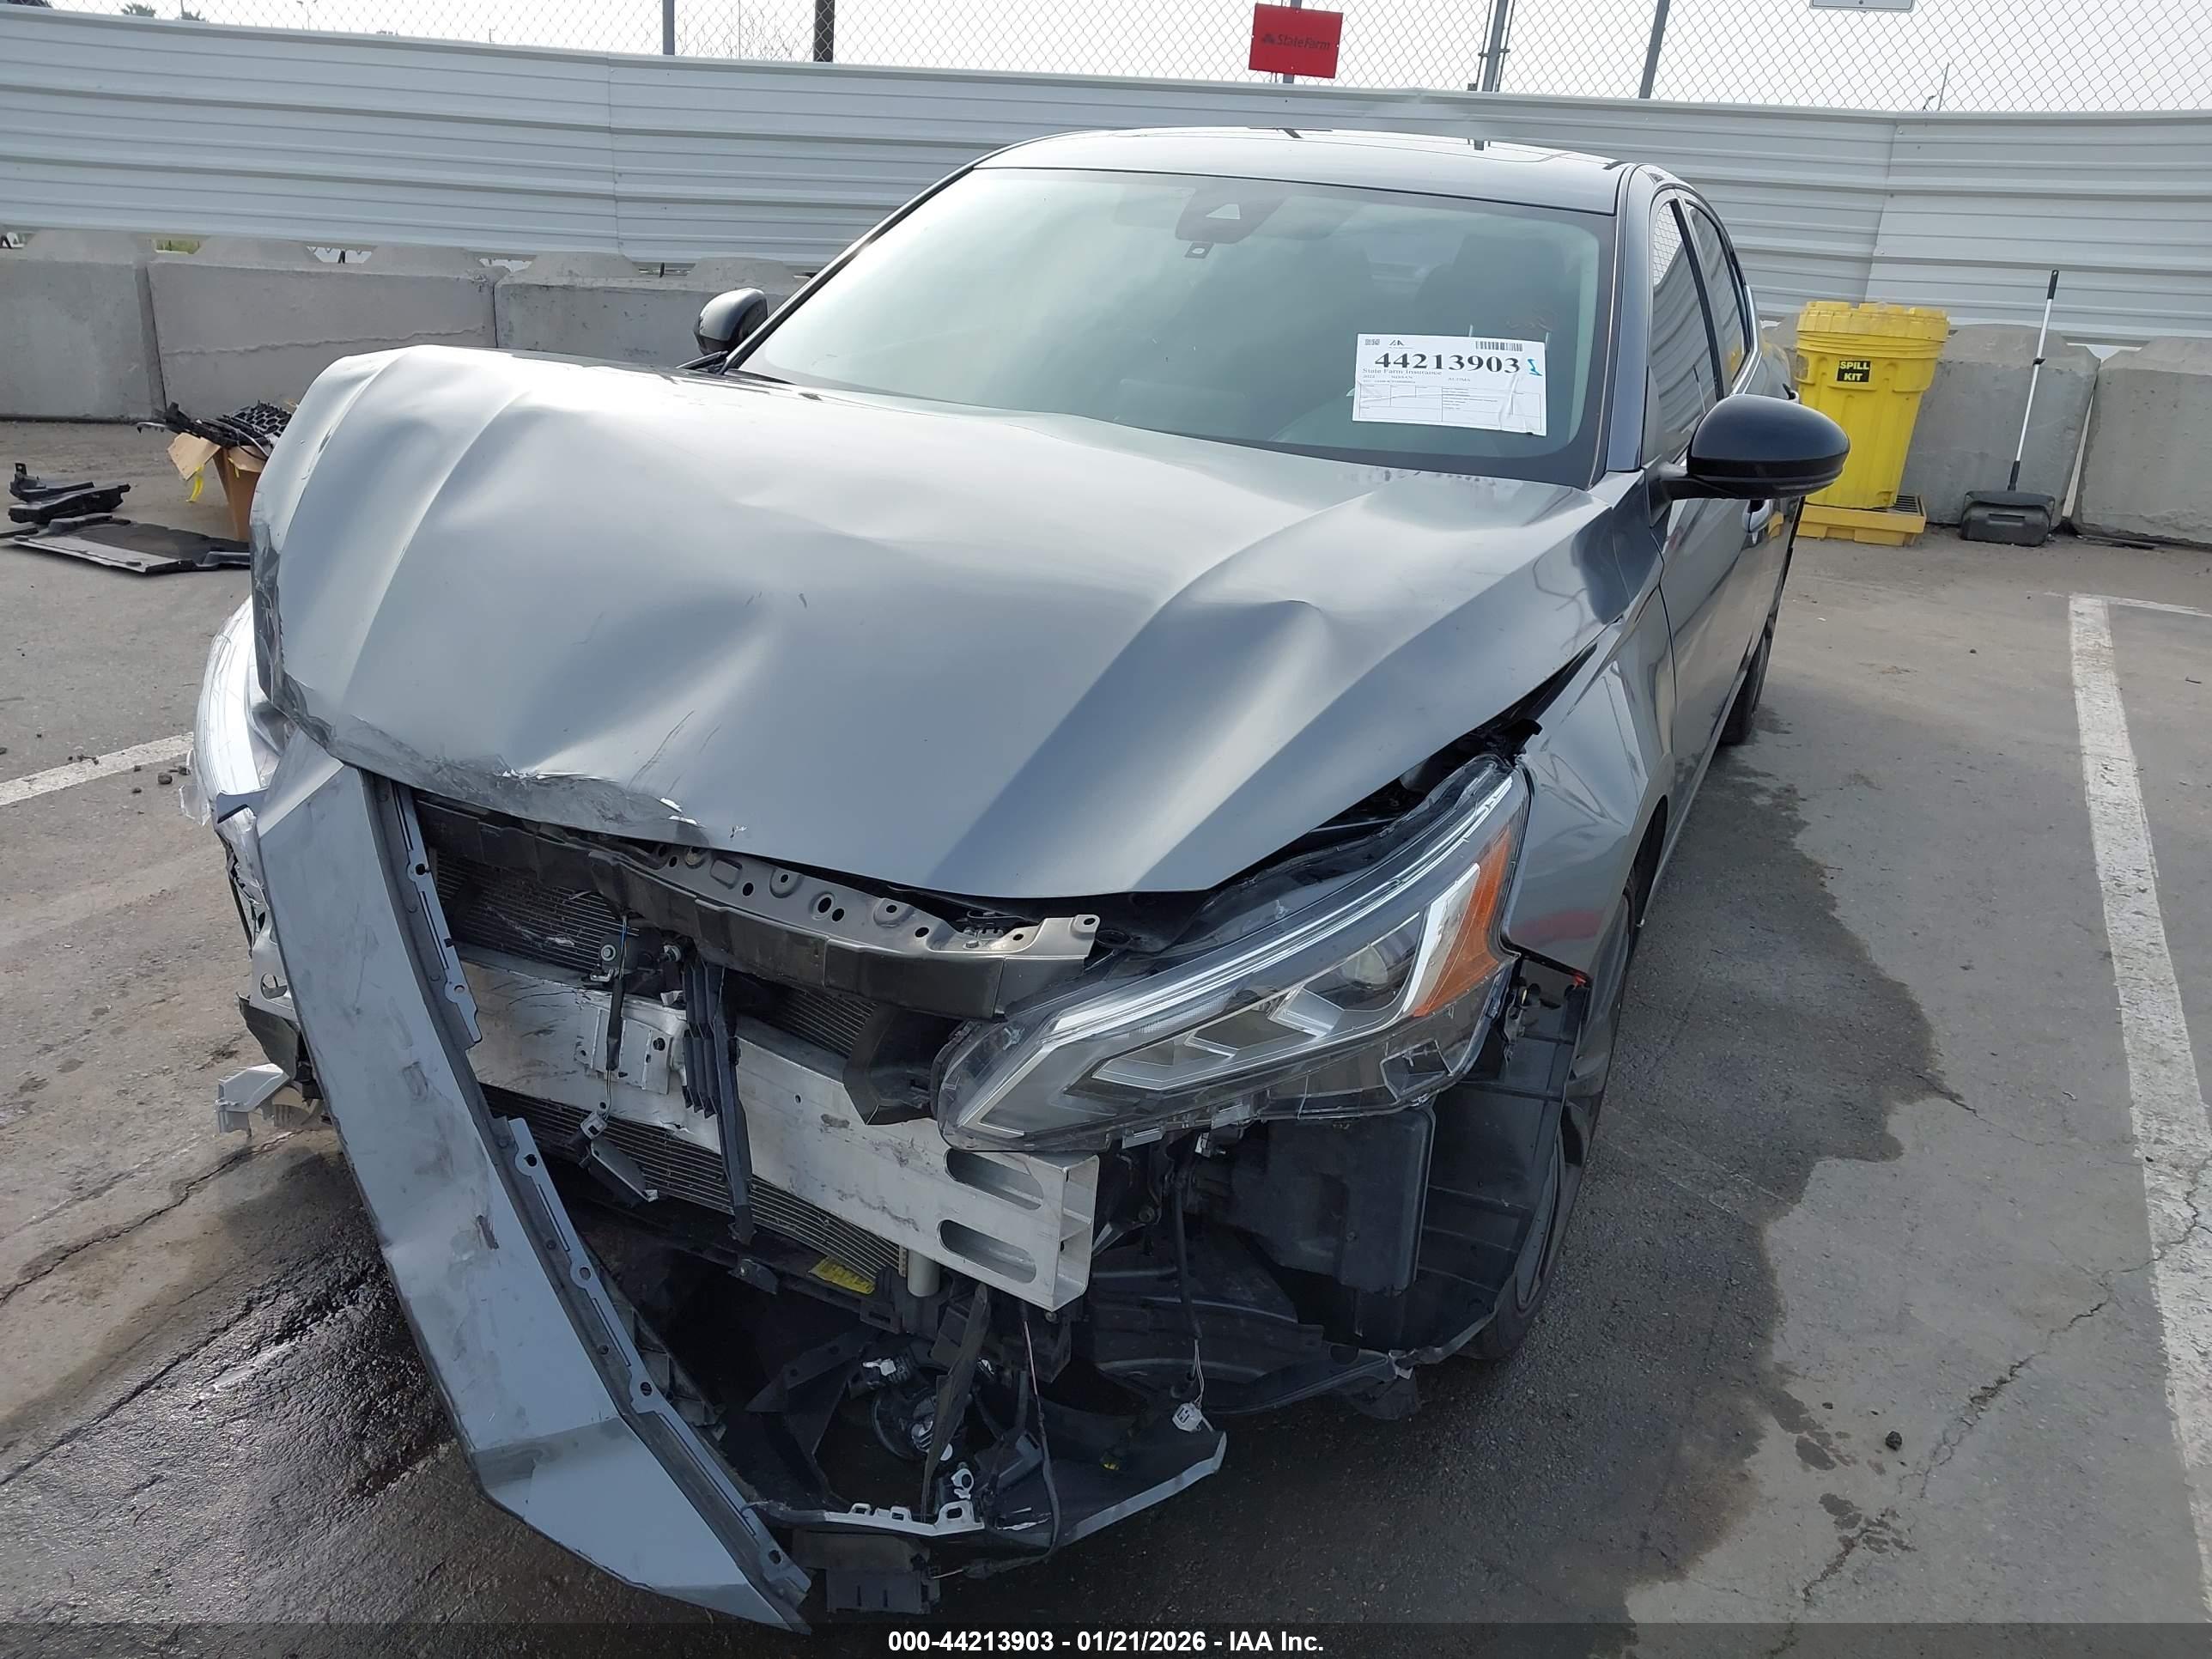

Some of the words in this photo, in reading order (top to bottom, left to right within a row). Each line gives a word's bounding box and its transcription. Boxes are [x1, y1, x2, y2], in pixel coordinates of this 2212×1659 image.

[1375, 352, 1521, 374] 44213903
[1839, 362, 1869, 370] SPILL
[1844, 373, 1863, 381] KIT
